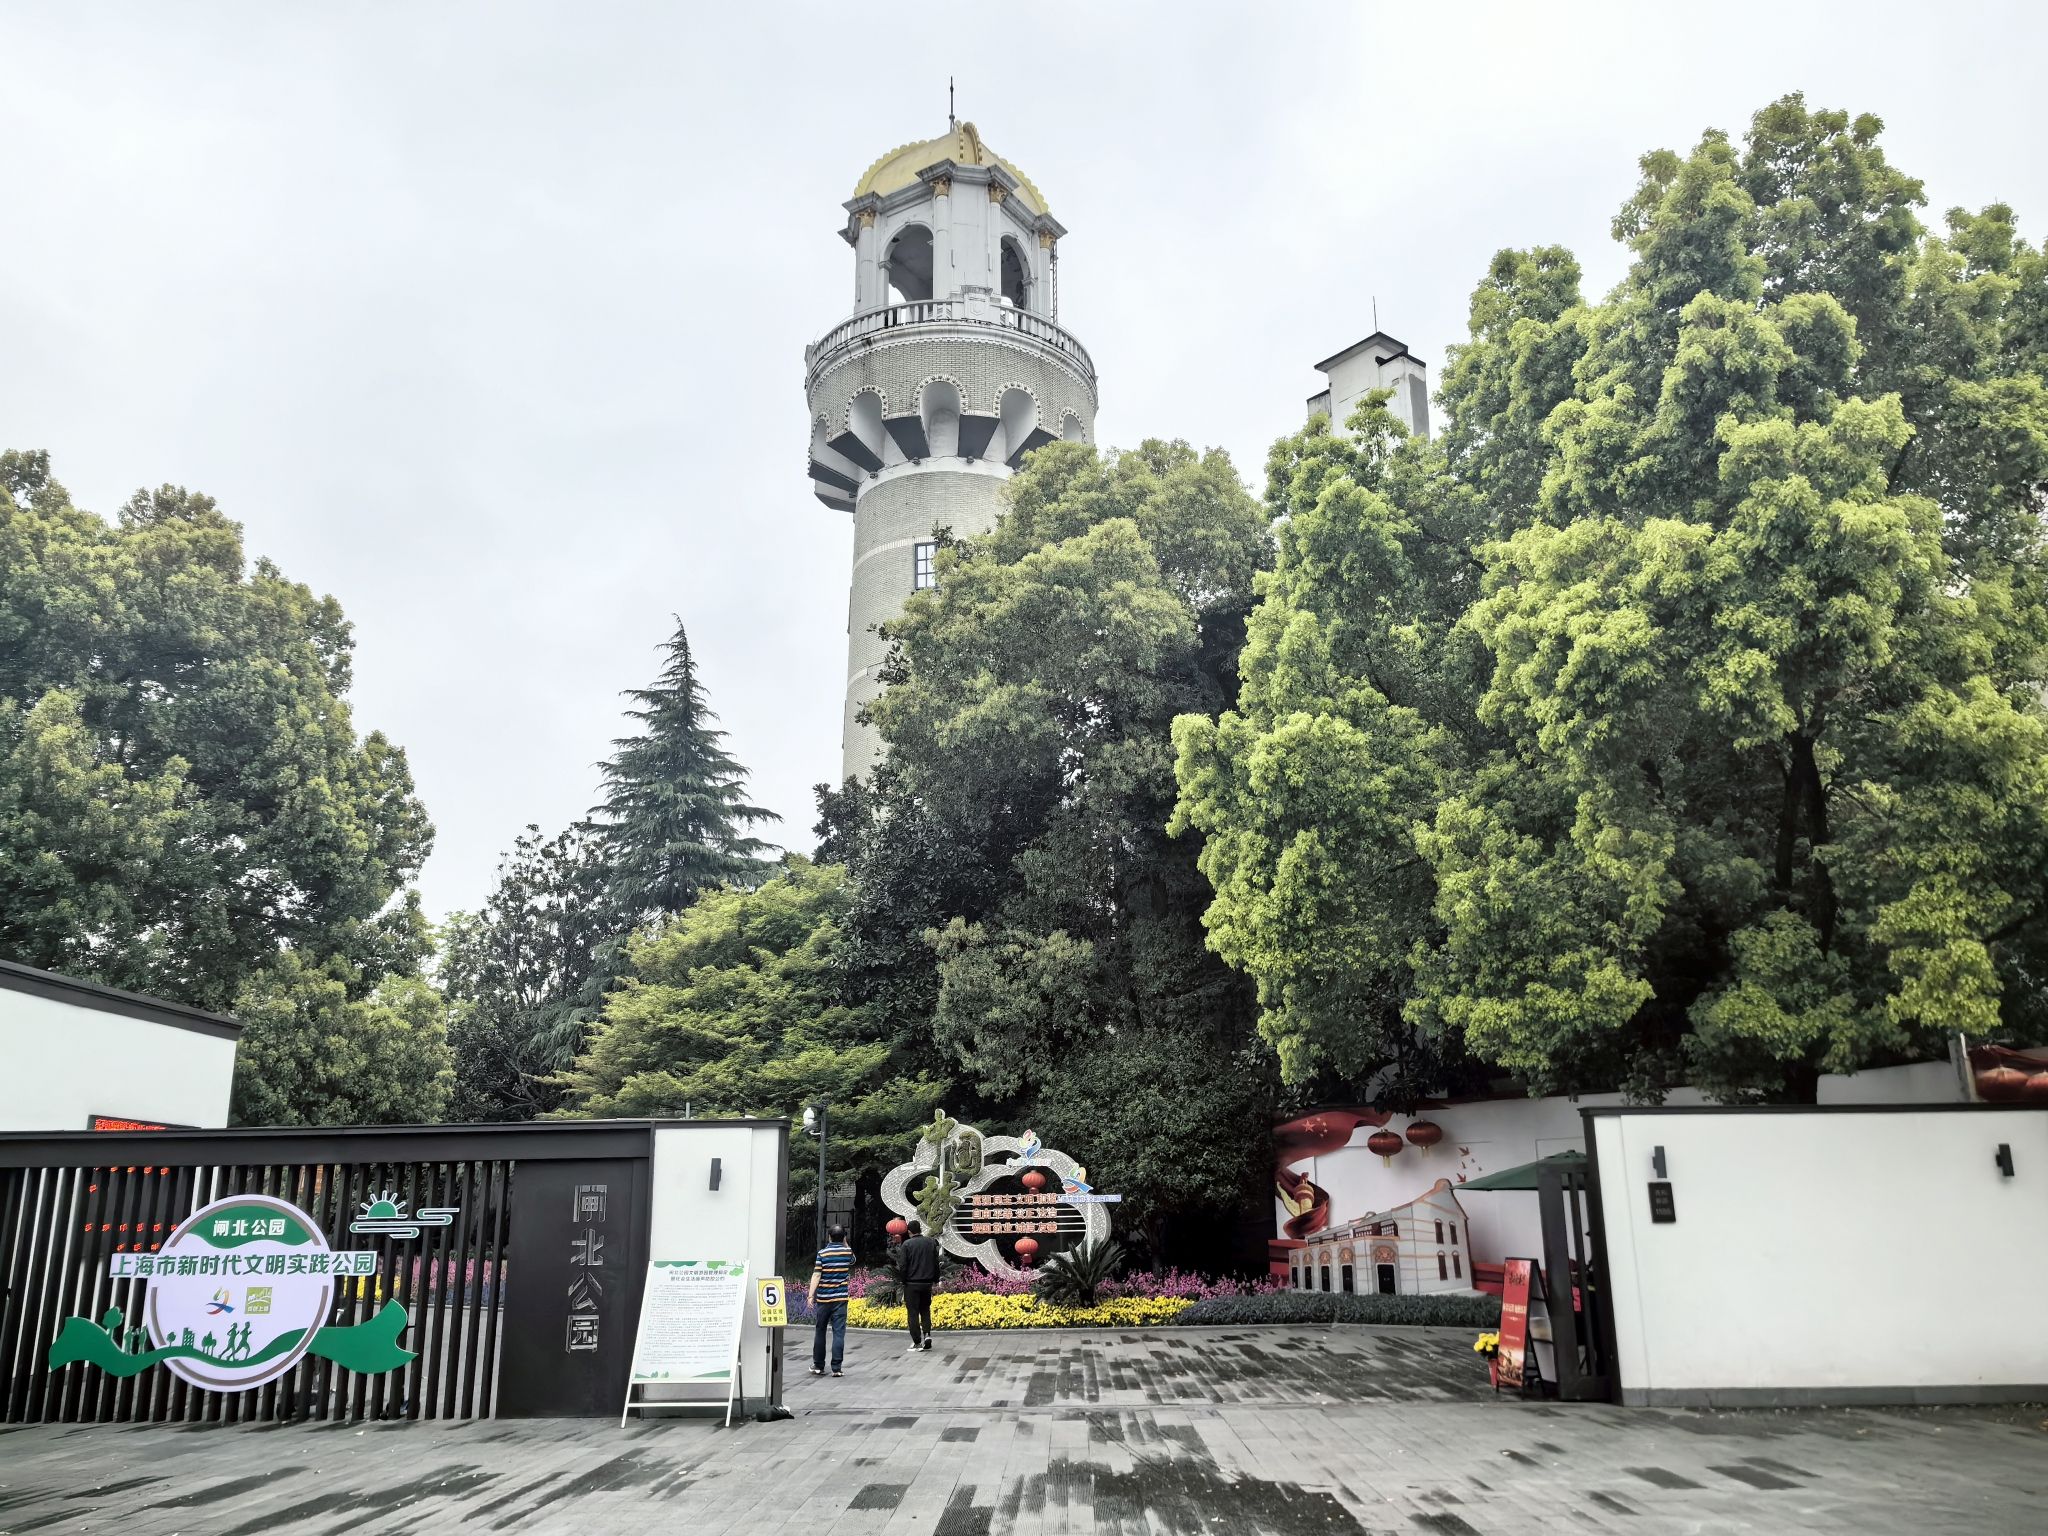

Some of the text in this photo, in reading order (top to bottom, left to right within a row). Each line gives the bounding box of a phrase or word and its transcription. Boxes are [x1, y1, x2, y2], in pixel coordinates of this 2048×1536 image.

[213, 1219, 286, 1237] 闸北公园
[112, 1253, 375, 1277] 上海市新时代文明实践公园
[566, 1184, 607, 1354] 闸北公园
[766, 1286, 777, 1305] 5
